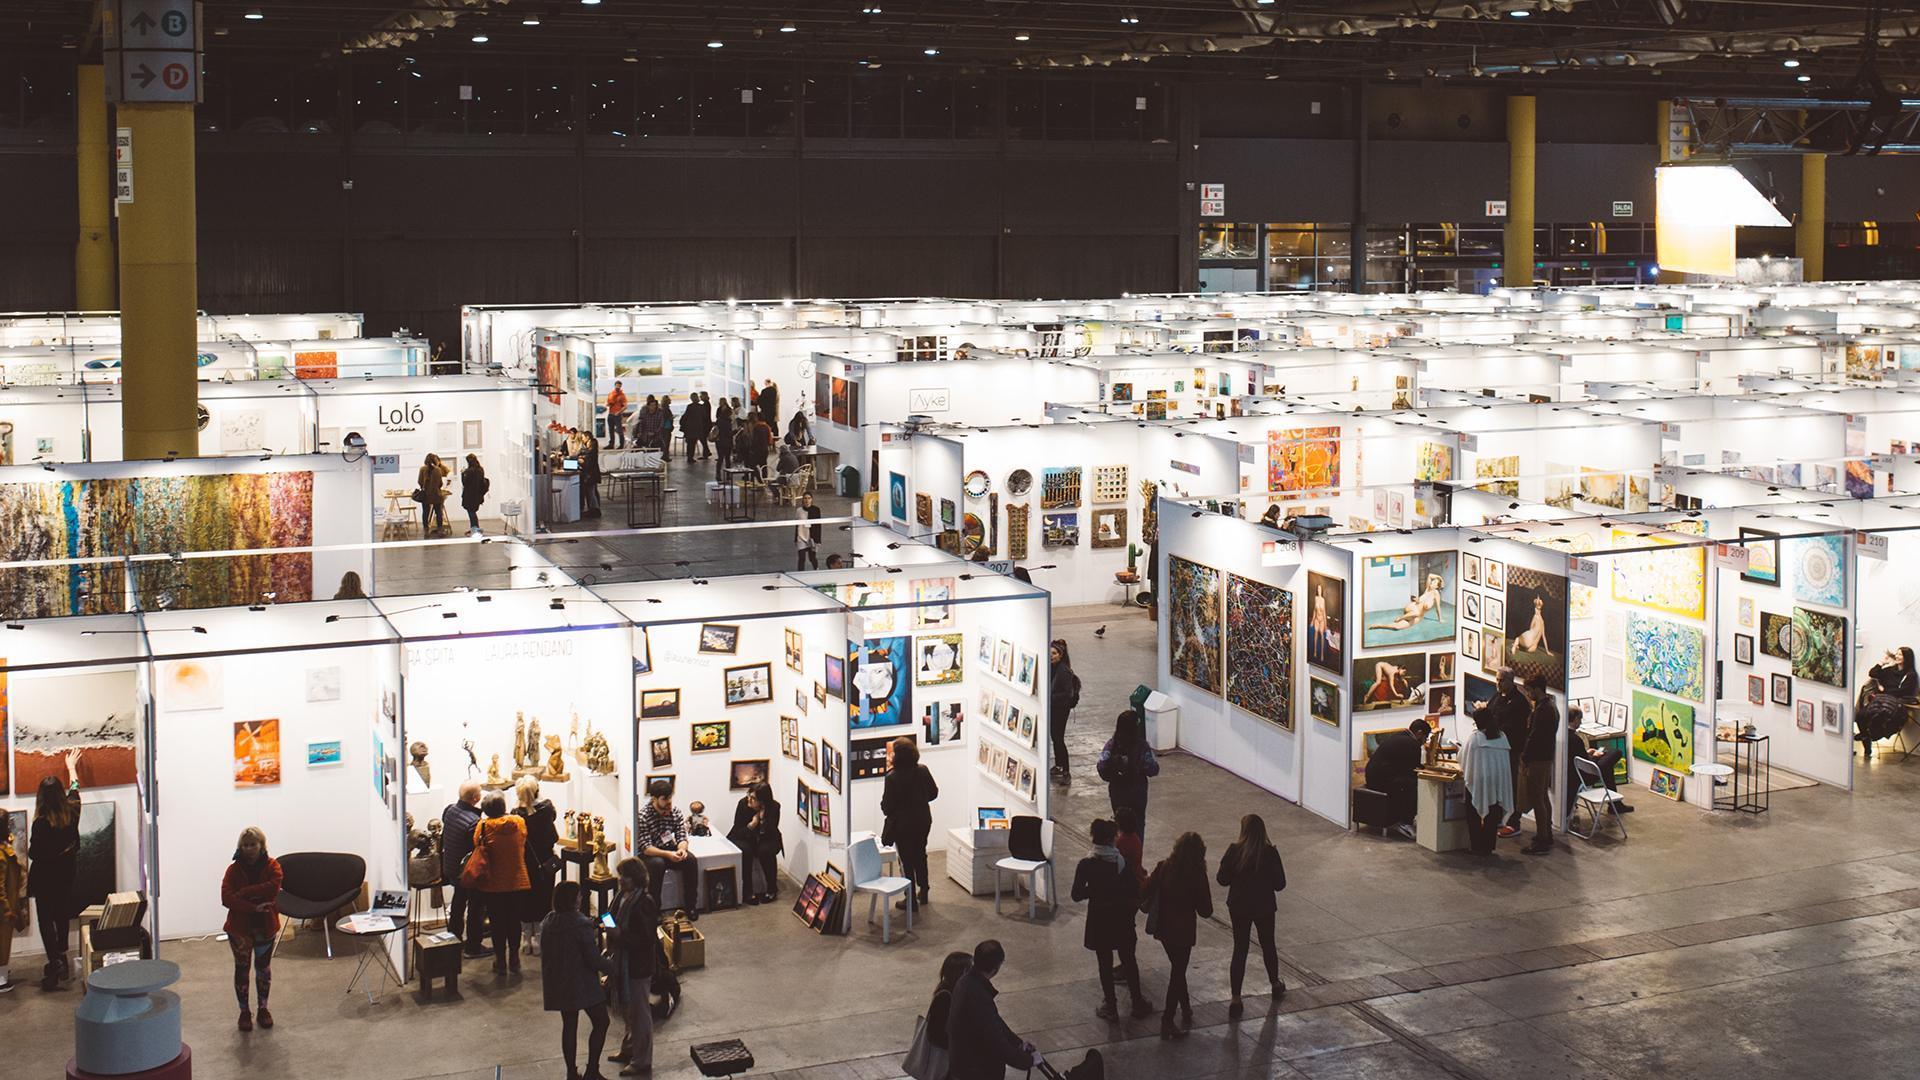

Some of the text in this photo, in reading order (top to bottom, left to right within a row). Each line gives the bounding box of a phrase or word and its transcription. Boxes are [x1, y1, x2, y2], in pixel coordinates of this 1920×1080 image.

[168, 15, 182, 32] B
[169, 67, 184, 85] D
[379, 401, 424, 425] Loló
[380, 456, 395, 464] 193
[1869, 536, 1884, 547] 210
[1730, 547, 1745, 559] 209
[1580, 561, 1593, 573] 208
[481, 641, 519, 662] LAURA
